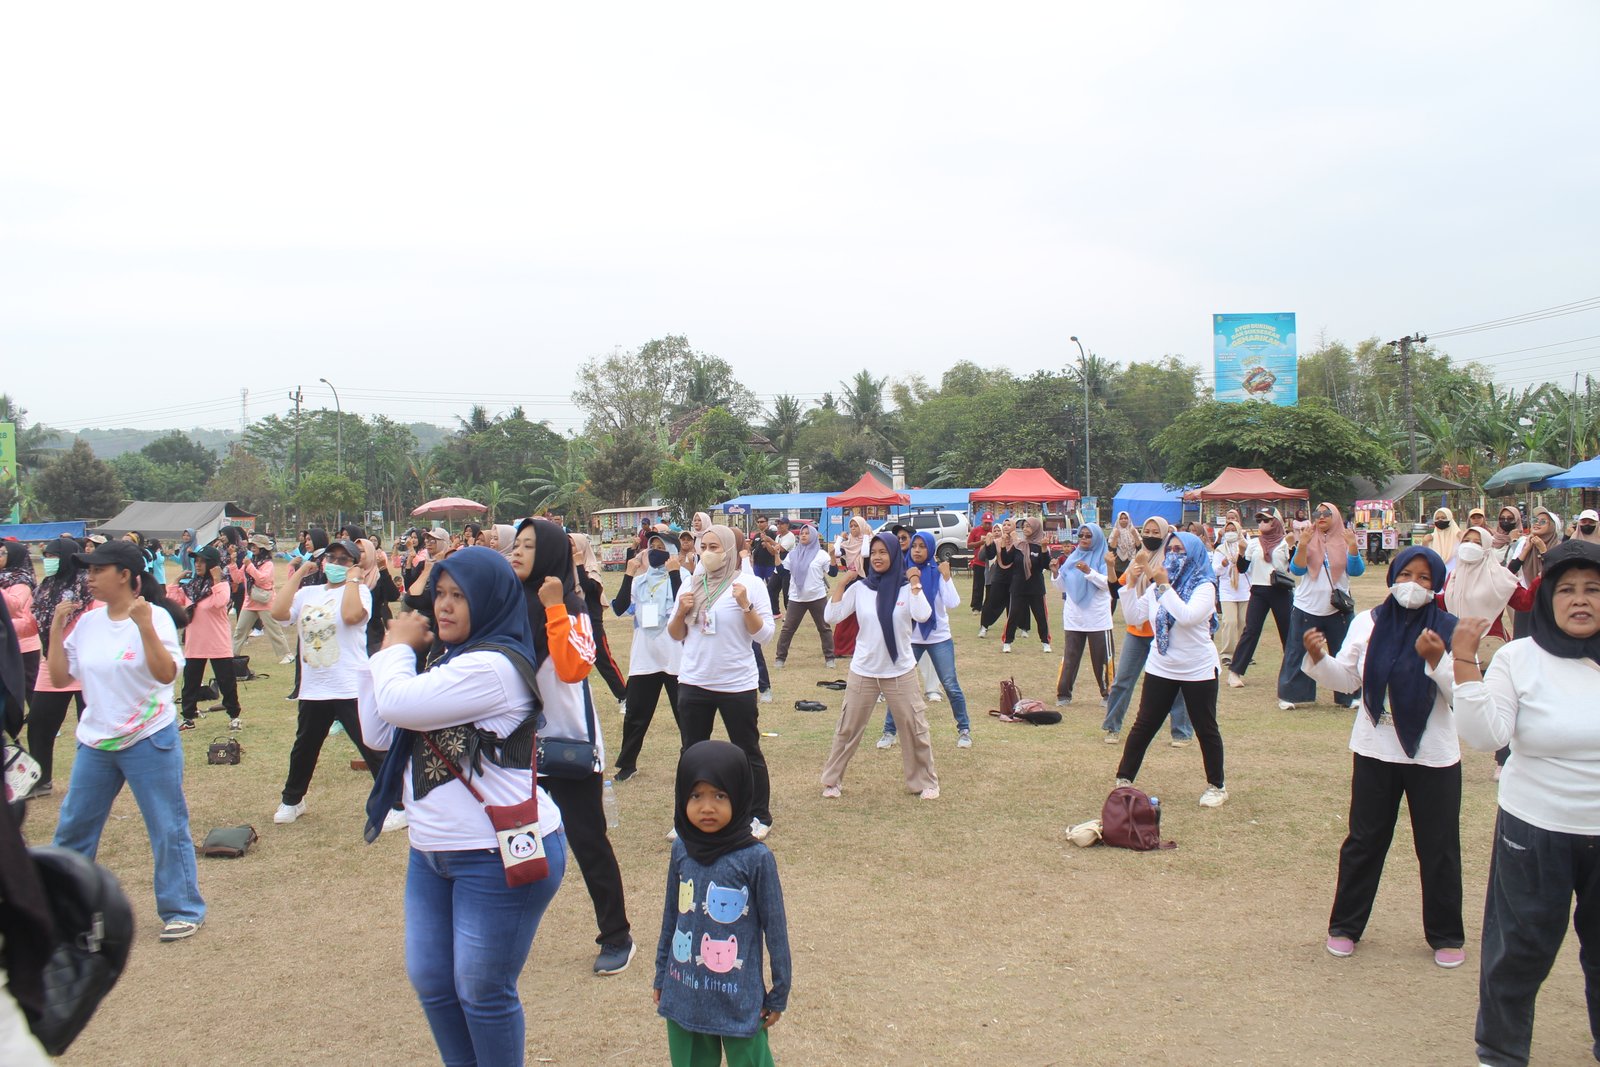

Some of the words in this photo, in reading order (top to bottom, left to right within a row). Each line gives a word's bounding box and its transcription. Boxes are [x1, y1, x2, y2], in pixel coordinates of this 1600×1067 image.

[669, 963, 680, 981] Cute
[682, 970, 698, 989] Little
[704, 975, 738, 993] Kittens
